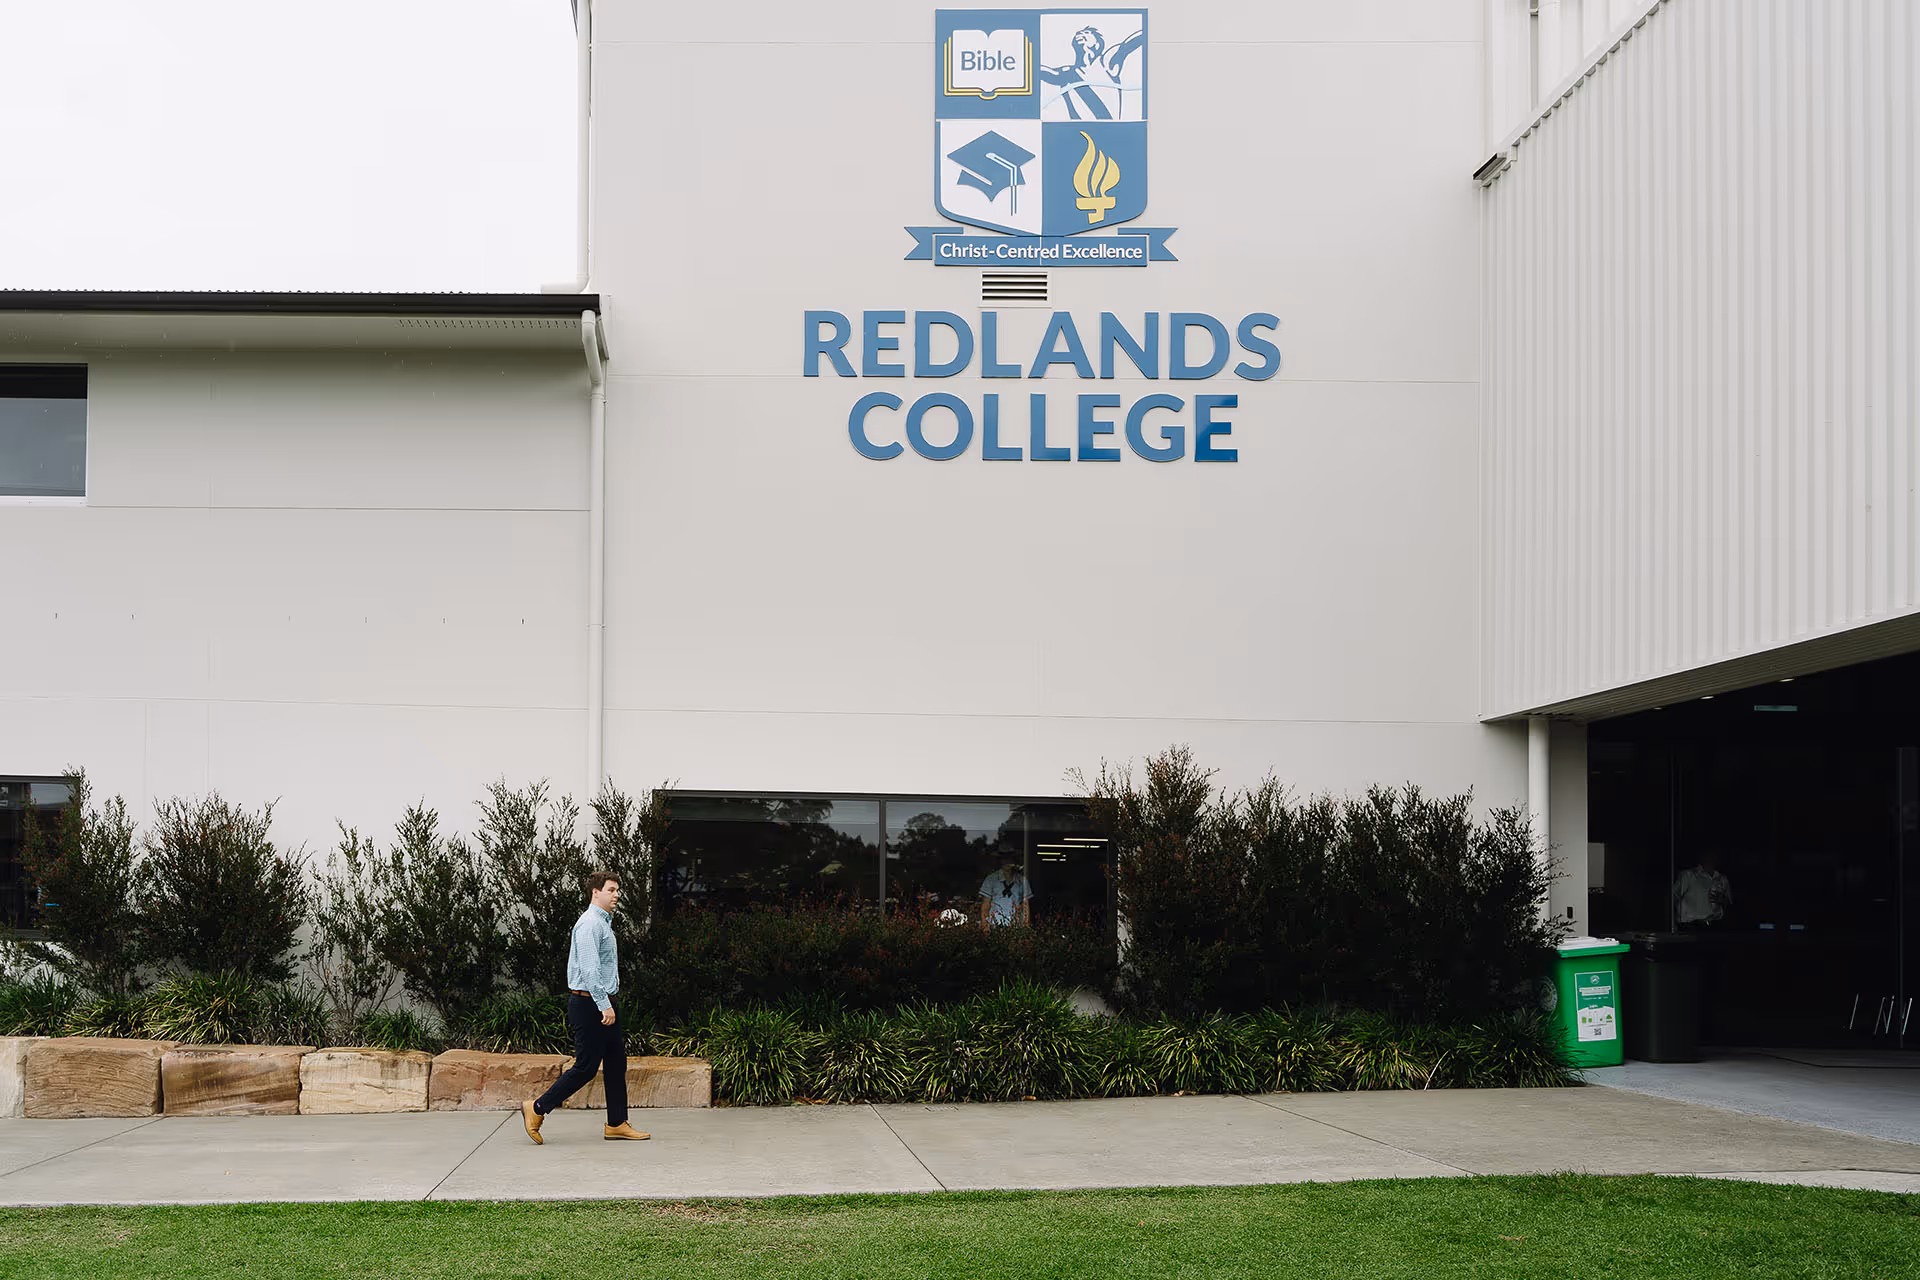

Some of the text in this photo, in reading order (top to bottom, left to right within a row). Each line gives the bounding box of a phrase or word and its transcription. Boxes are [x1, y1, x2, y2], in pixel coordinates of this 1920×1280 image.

[961, 50, 1016, 71] Bible
[940, 242, 1143, 260] Christ-Centred Excellence
[804, 310, 1281, 381] REDLANDS
[849, 392, 1238, 462] COLLEGE
